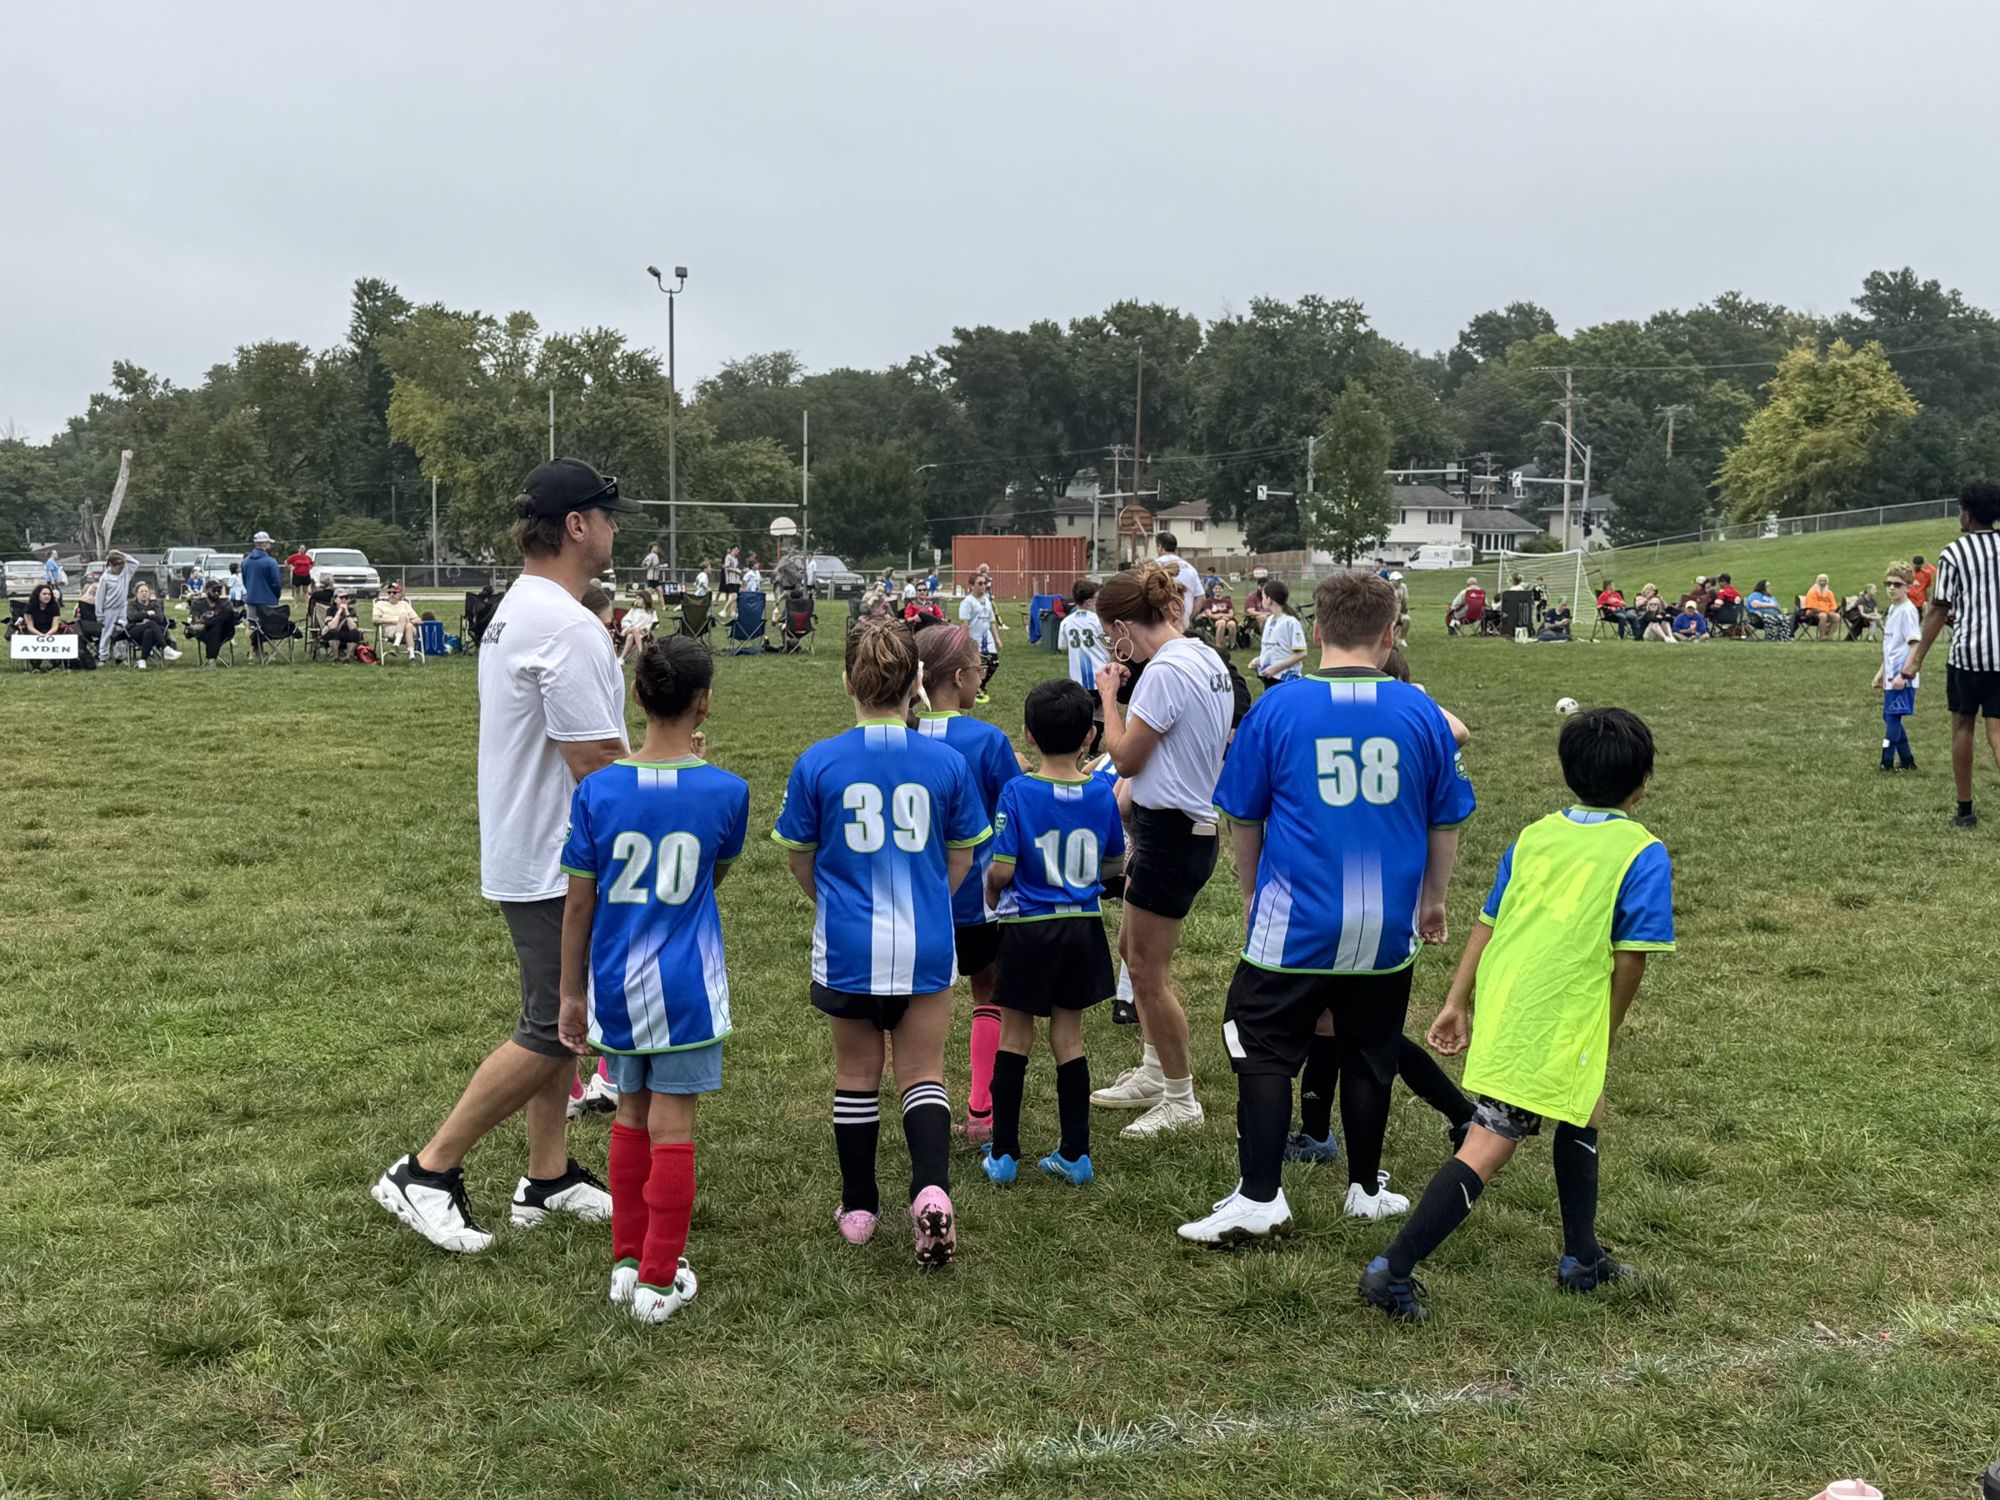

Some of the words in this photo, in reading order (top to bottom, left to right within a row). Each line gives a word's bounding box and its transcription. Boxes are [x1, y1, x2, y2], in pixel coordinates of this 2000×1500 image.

[21, 645, 71, 653] AYDEN
[36, 635, 55, 643] GO
[1069, 628, 1096, 649] 33
[1314, 736, 1400, 807] 58
[842, 782, 931, 854] 39
[607, 831, 701, 906] 20
[1034, 828, 1099, 889] 10
